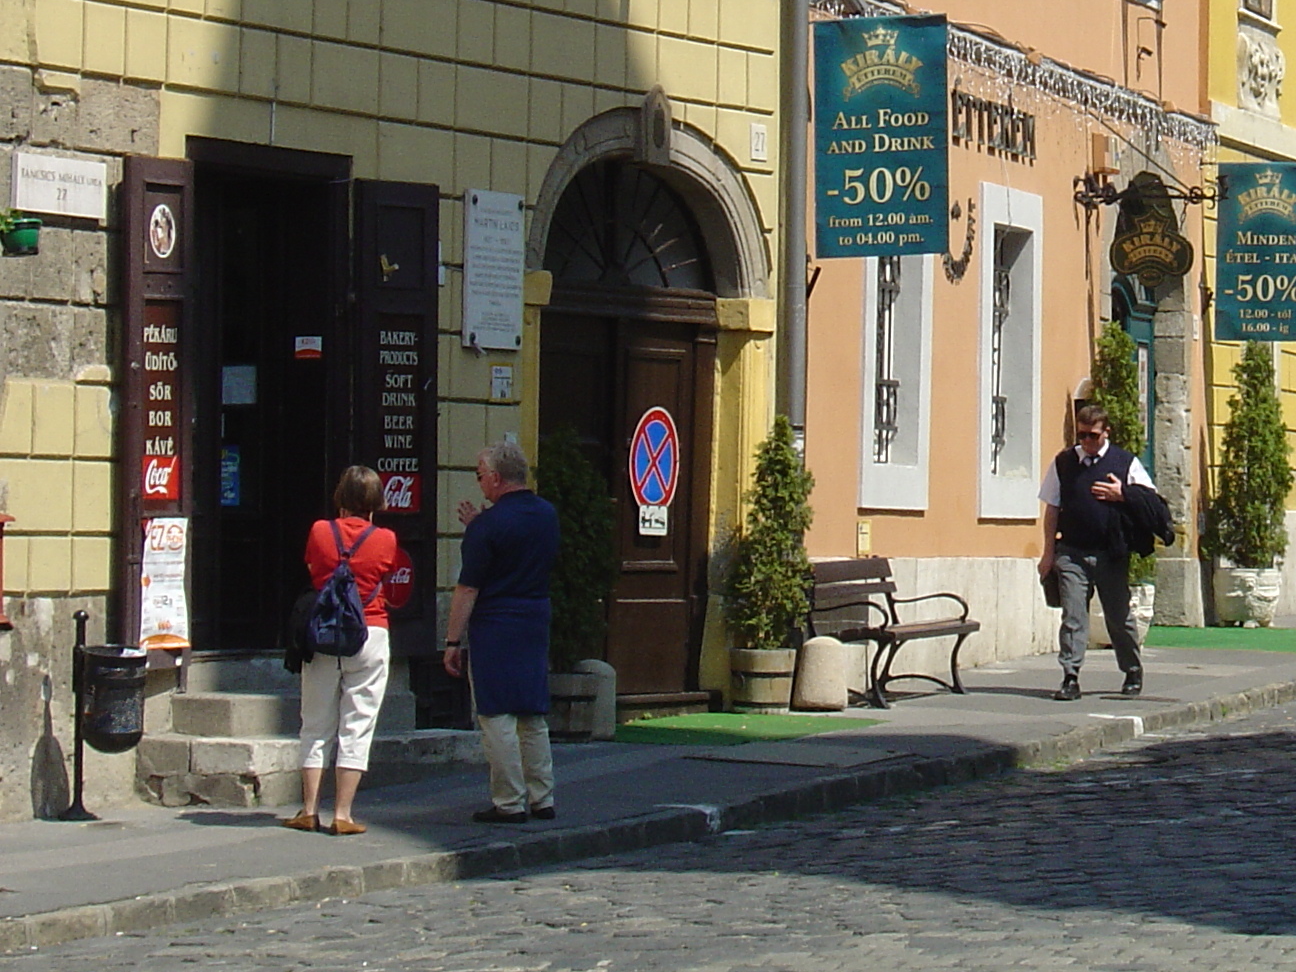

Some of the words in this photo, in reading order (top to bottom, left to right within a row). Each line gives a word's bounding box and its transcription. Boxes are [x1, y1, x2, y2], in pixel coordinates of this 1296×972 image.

[840, 45, 924, 77] KIRÁLY
[832, 111, 872, 130] ALL
[877, 108, 930, 128] FOOD
[754, 131, 765, 152] 27
[873, 133, 935, 152] DRINK
[826, 166, 931, 205] -50%
[829, 215, 863, 228] from
[867, 212, 906, 226] 12.00
[839, 235, 853, 246] to
[856, 231, 895, 245] 04.00
[898, 233, 925, 247] pm.
[1236, 230, 1296, 246] MINDEN
[1225, 249, 1261, 264] ÉTEL
[1239, 309, 1268, 319] 12.00
[1241, 323, 1270, 333] 16.00
[379, 351, 418, 365] PRODUCTS
[385, 374, 413, 388] SOFT
[382, 393, 416, 407] DRINK
[149, 411, 172, 427] BOR
[384, 415, 413, 429] BEER
[384, 434, 413, 449] WINE
[377, 457, 419, 472] COFFEE
